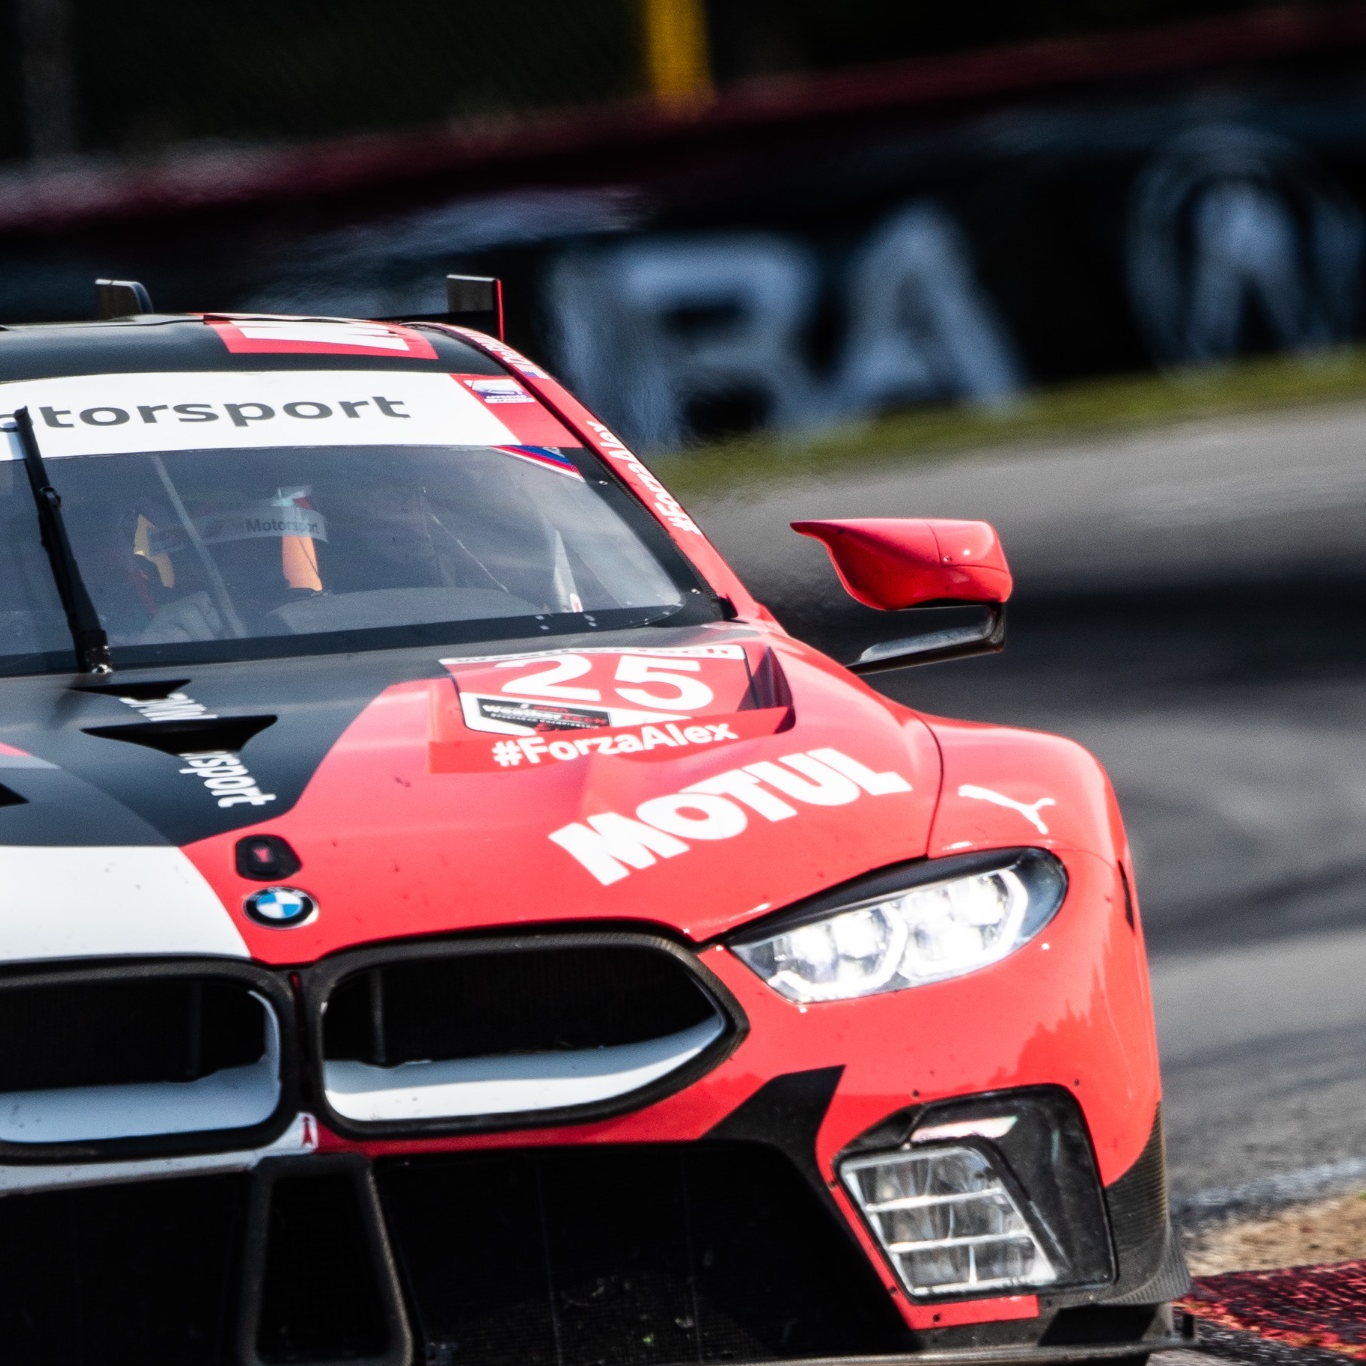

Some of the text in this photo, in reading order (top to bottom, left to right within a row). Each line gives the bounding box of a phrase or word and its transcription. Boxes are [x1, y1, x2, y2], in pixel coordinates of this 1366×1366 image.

[553, 205, 1030, 470] RA
[494, 653, 714, 711] 25
[491, 722, 739, 767] #ForzaAlex
[178, 752, 276, 808] rsport
[548, 747, 913, 887] MOTUL
